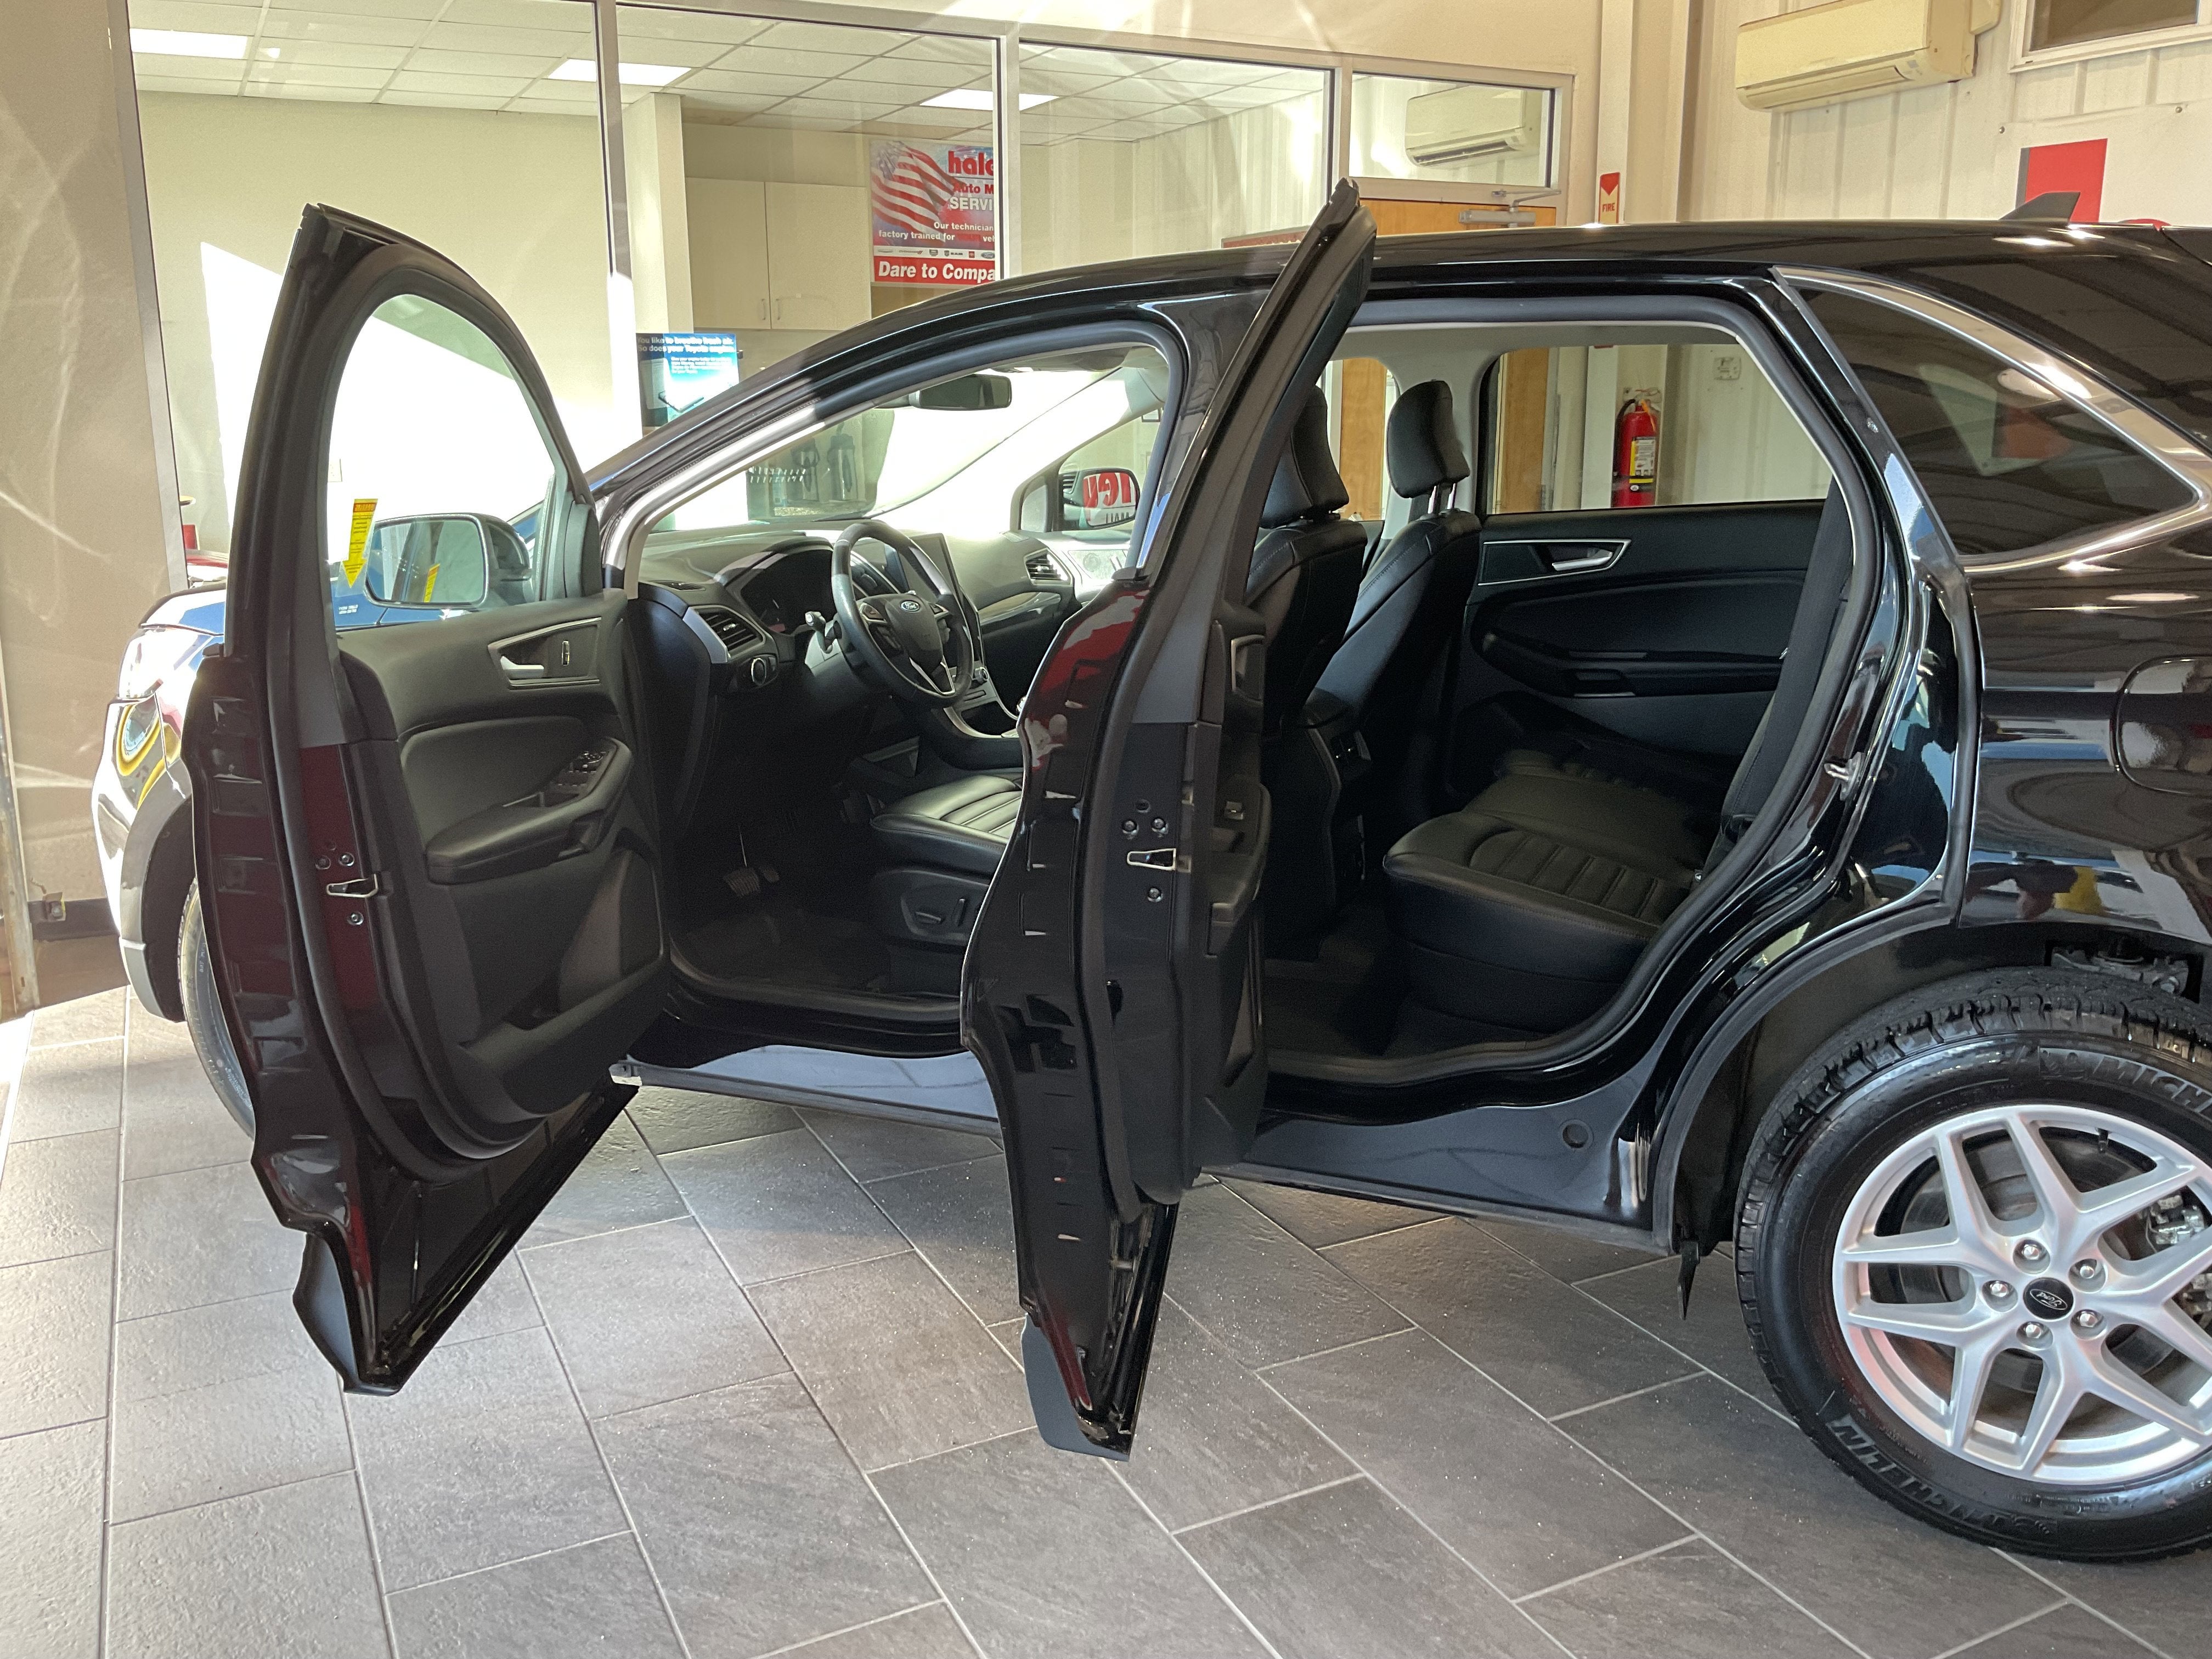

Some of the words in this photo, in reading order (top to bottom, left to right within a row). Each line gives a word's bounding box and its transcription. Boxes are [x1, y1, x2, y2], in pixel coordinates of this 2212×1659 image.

[953, 183, 980, 194] Auto
[949, 196, 992, 211] SERVI
[1602, 203, 1615, 212] FIRE
[951, 222, 994, 231] technician
[879, 230, 908, 240] factory
[911, 232, 940, 240] trained
[943, 233, 955, 241] for
[879, 261, 916, 277] Dare
[922, 263, 938, 278] to
[2091, 1054, 2211, 1114] MICH
[2036, 1291, 2062, 1307] Ford
